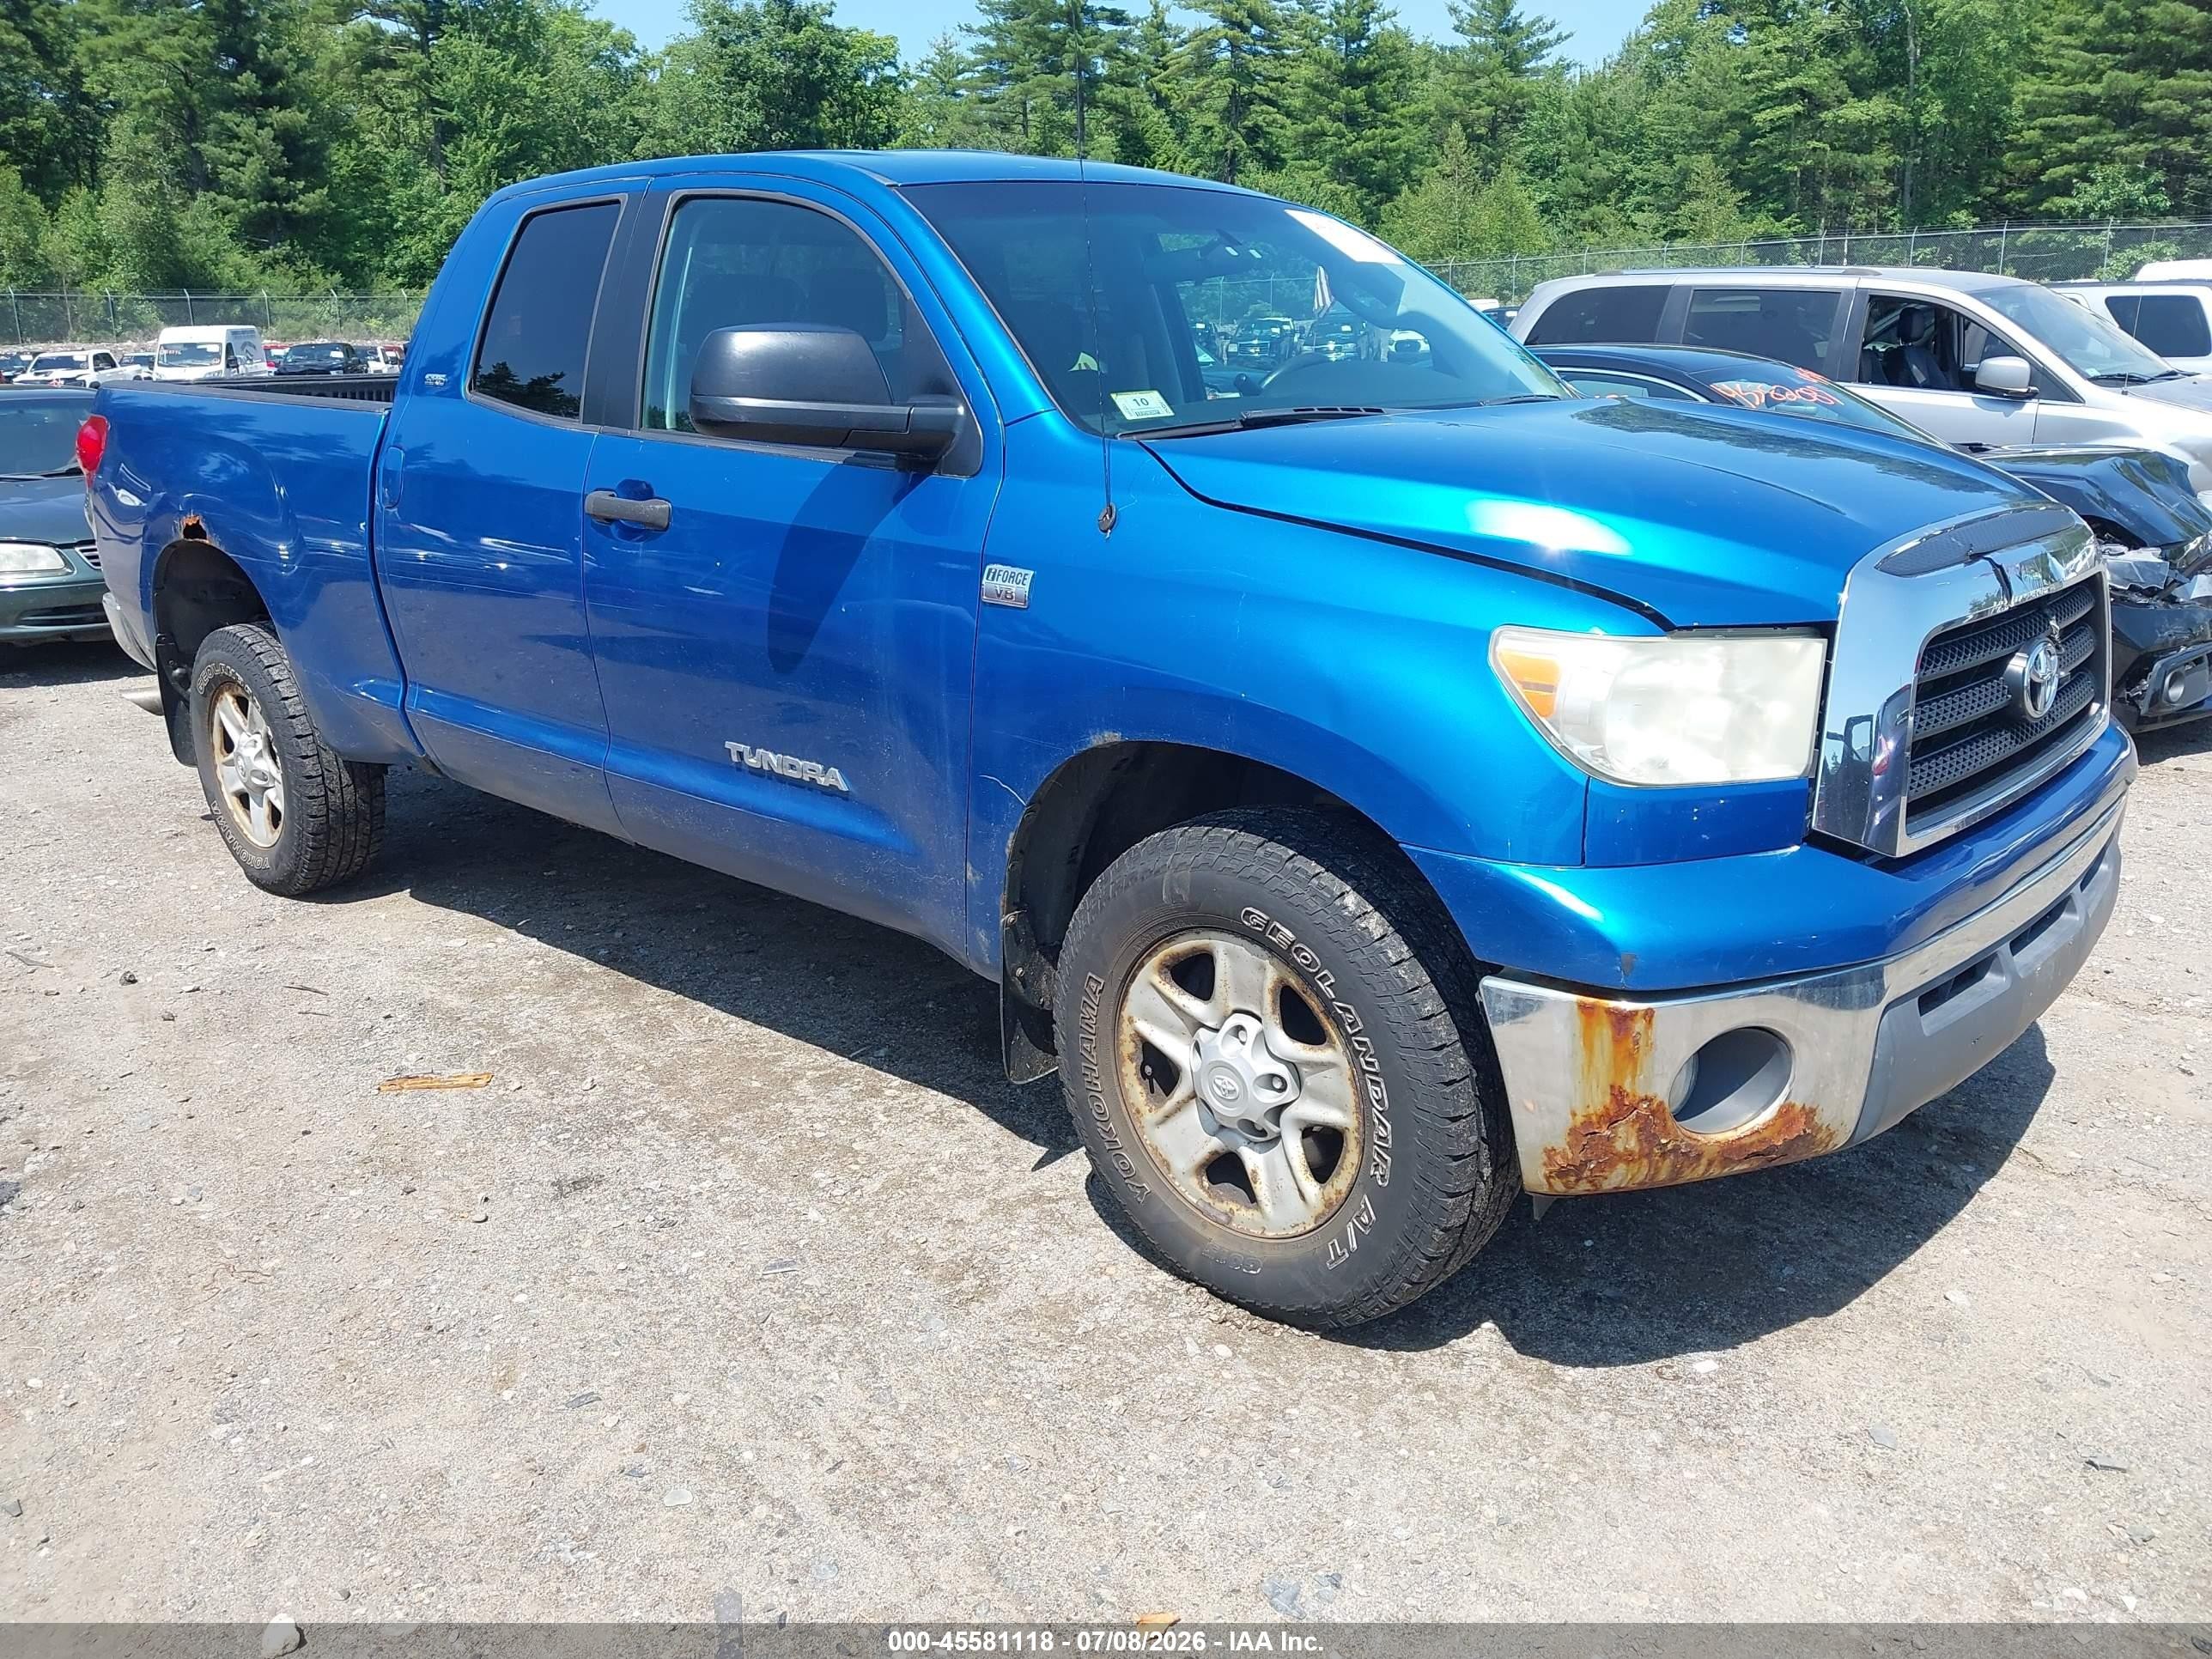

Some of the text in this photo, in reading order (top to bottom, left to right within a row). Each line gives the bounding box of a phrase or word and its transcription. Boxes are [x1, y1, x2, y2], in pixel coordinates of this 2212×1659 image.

[1133, 398, 1149, 407] 10
[995, 586, 1016, 600] V8
[725, 741, 850, 792] TUNDRA
[1079, 971, 1152, 1204] YOKOHAMA
[1240, 906, 1394, 1188] GEOLANDAR
[1326, 1194, 1377, 1270] A/T
